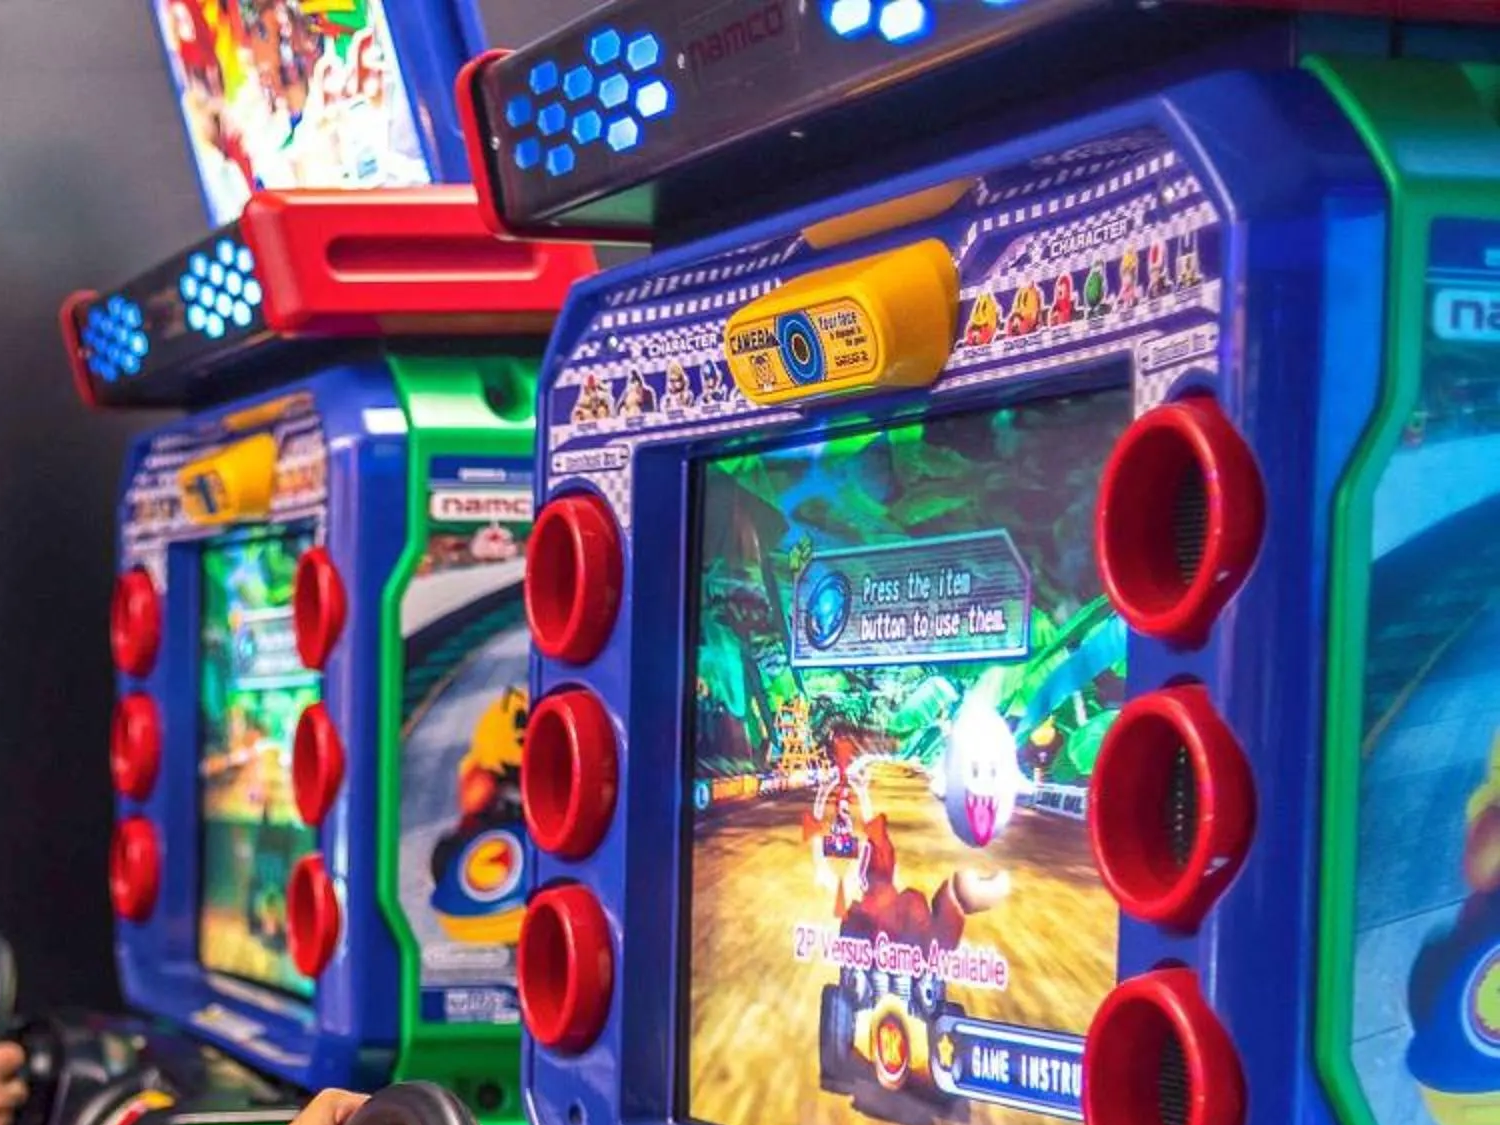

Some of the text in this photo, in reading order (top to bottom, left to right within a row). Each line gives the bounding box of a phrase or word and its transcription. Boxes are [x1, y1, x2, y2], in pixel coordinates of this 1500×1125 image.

[690, 3, 784, 69] namco
[1051, 221, 1128, 256] CHARACTER
[649, 333, 717, 357] CHARACTER
[443, 498, 528, 515] namc
[863, 568, 971, 603] Press the item
[860, 612, 906, 640] button
[913, 610, 928, 637] to
[935, 611, 959, 636] use
[796, 926, 1006, 986] 2P Versus Game Available
[971, 1045, 1083, 1098] GAME INSTRU
